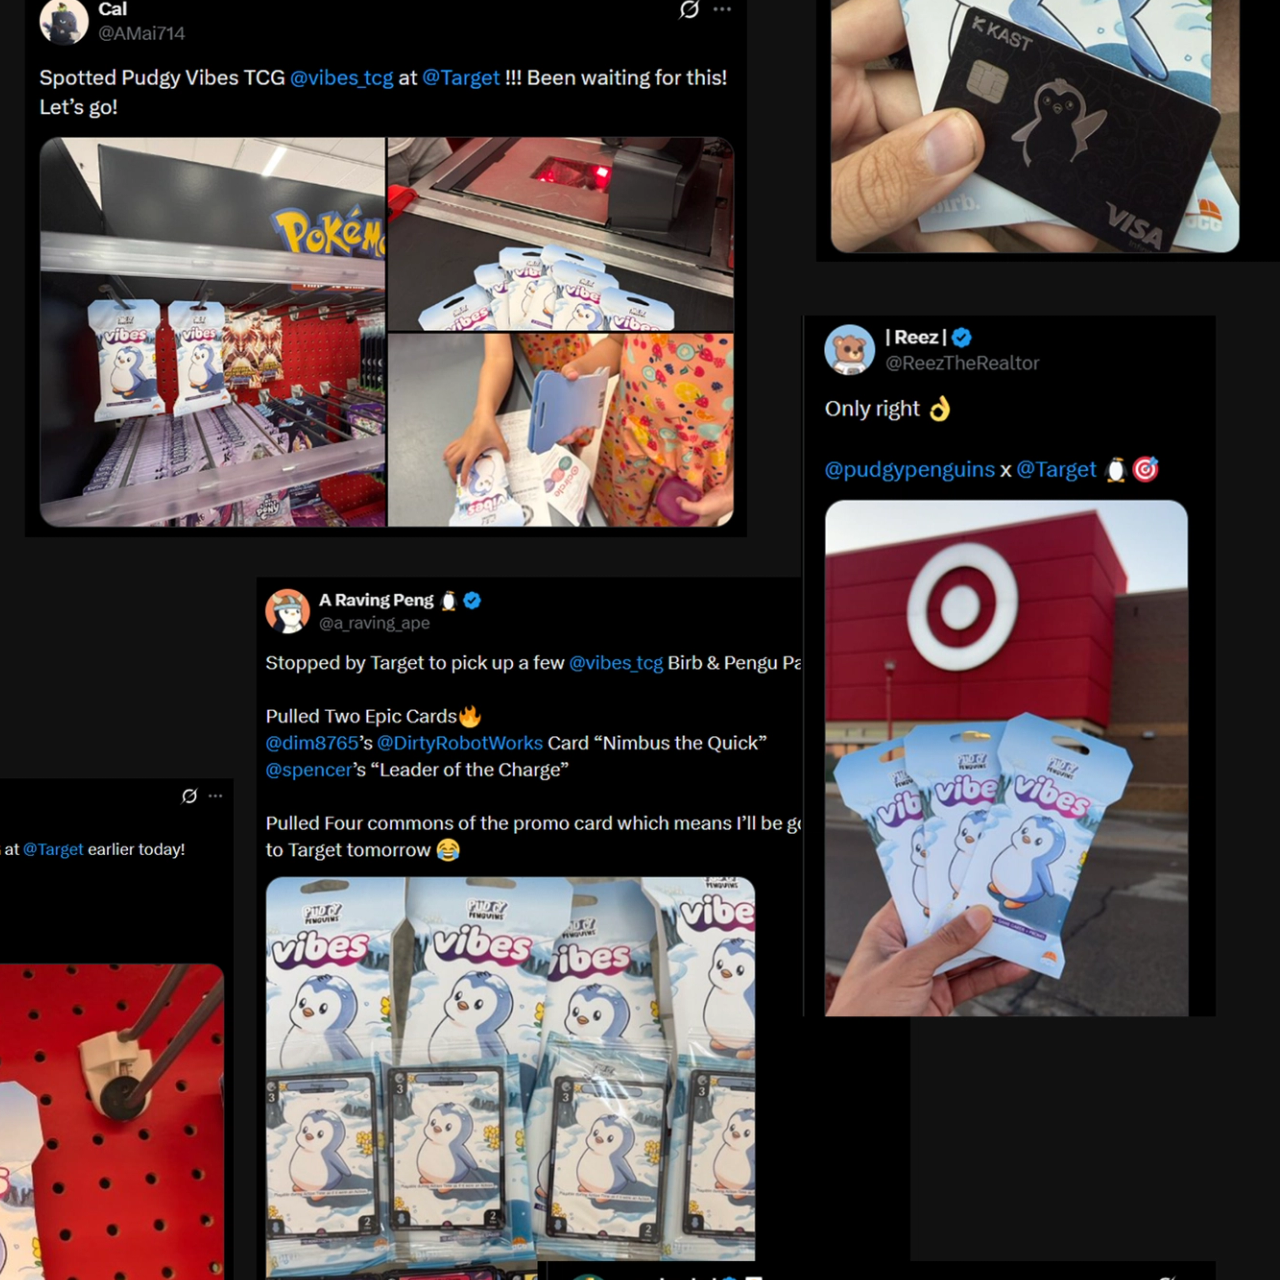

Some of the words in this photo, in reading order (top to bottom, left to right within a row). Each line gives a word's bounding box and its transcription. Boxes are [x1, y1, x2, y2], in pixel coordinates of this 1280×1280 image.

[99, 1, 127, 15] Cal
[99, 26, 185, 41] @AMai714
[986, 21, 1033, 51] KAST
[1106, 201, 1164, 250] VISA
[825, 400, 871, 421] Only
[877, 400, 920, 421] right
[319, 594, 331, 606] A
[336, 593, 390, 609] Raving
[394, 594, 434, 609] Peng
[433, 924, 533, 967] vibes
